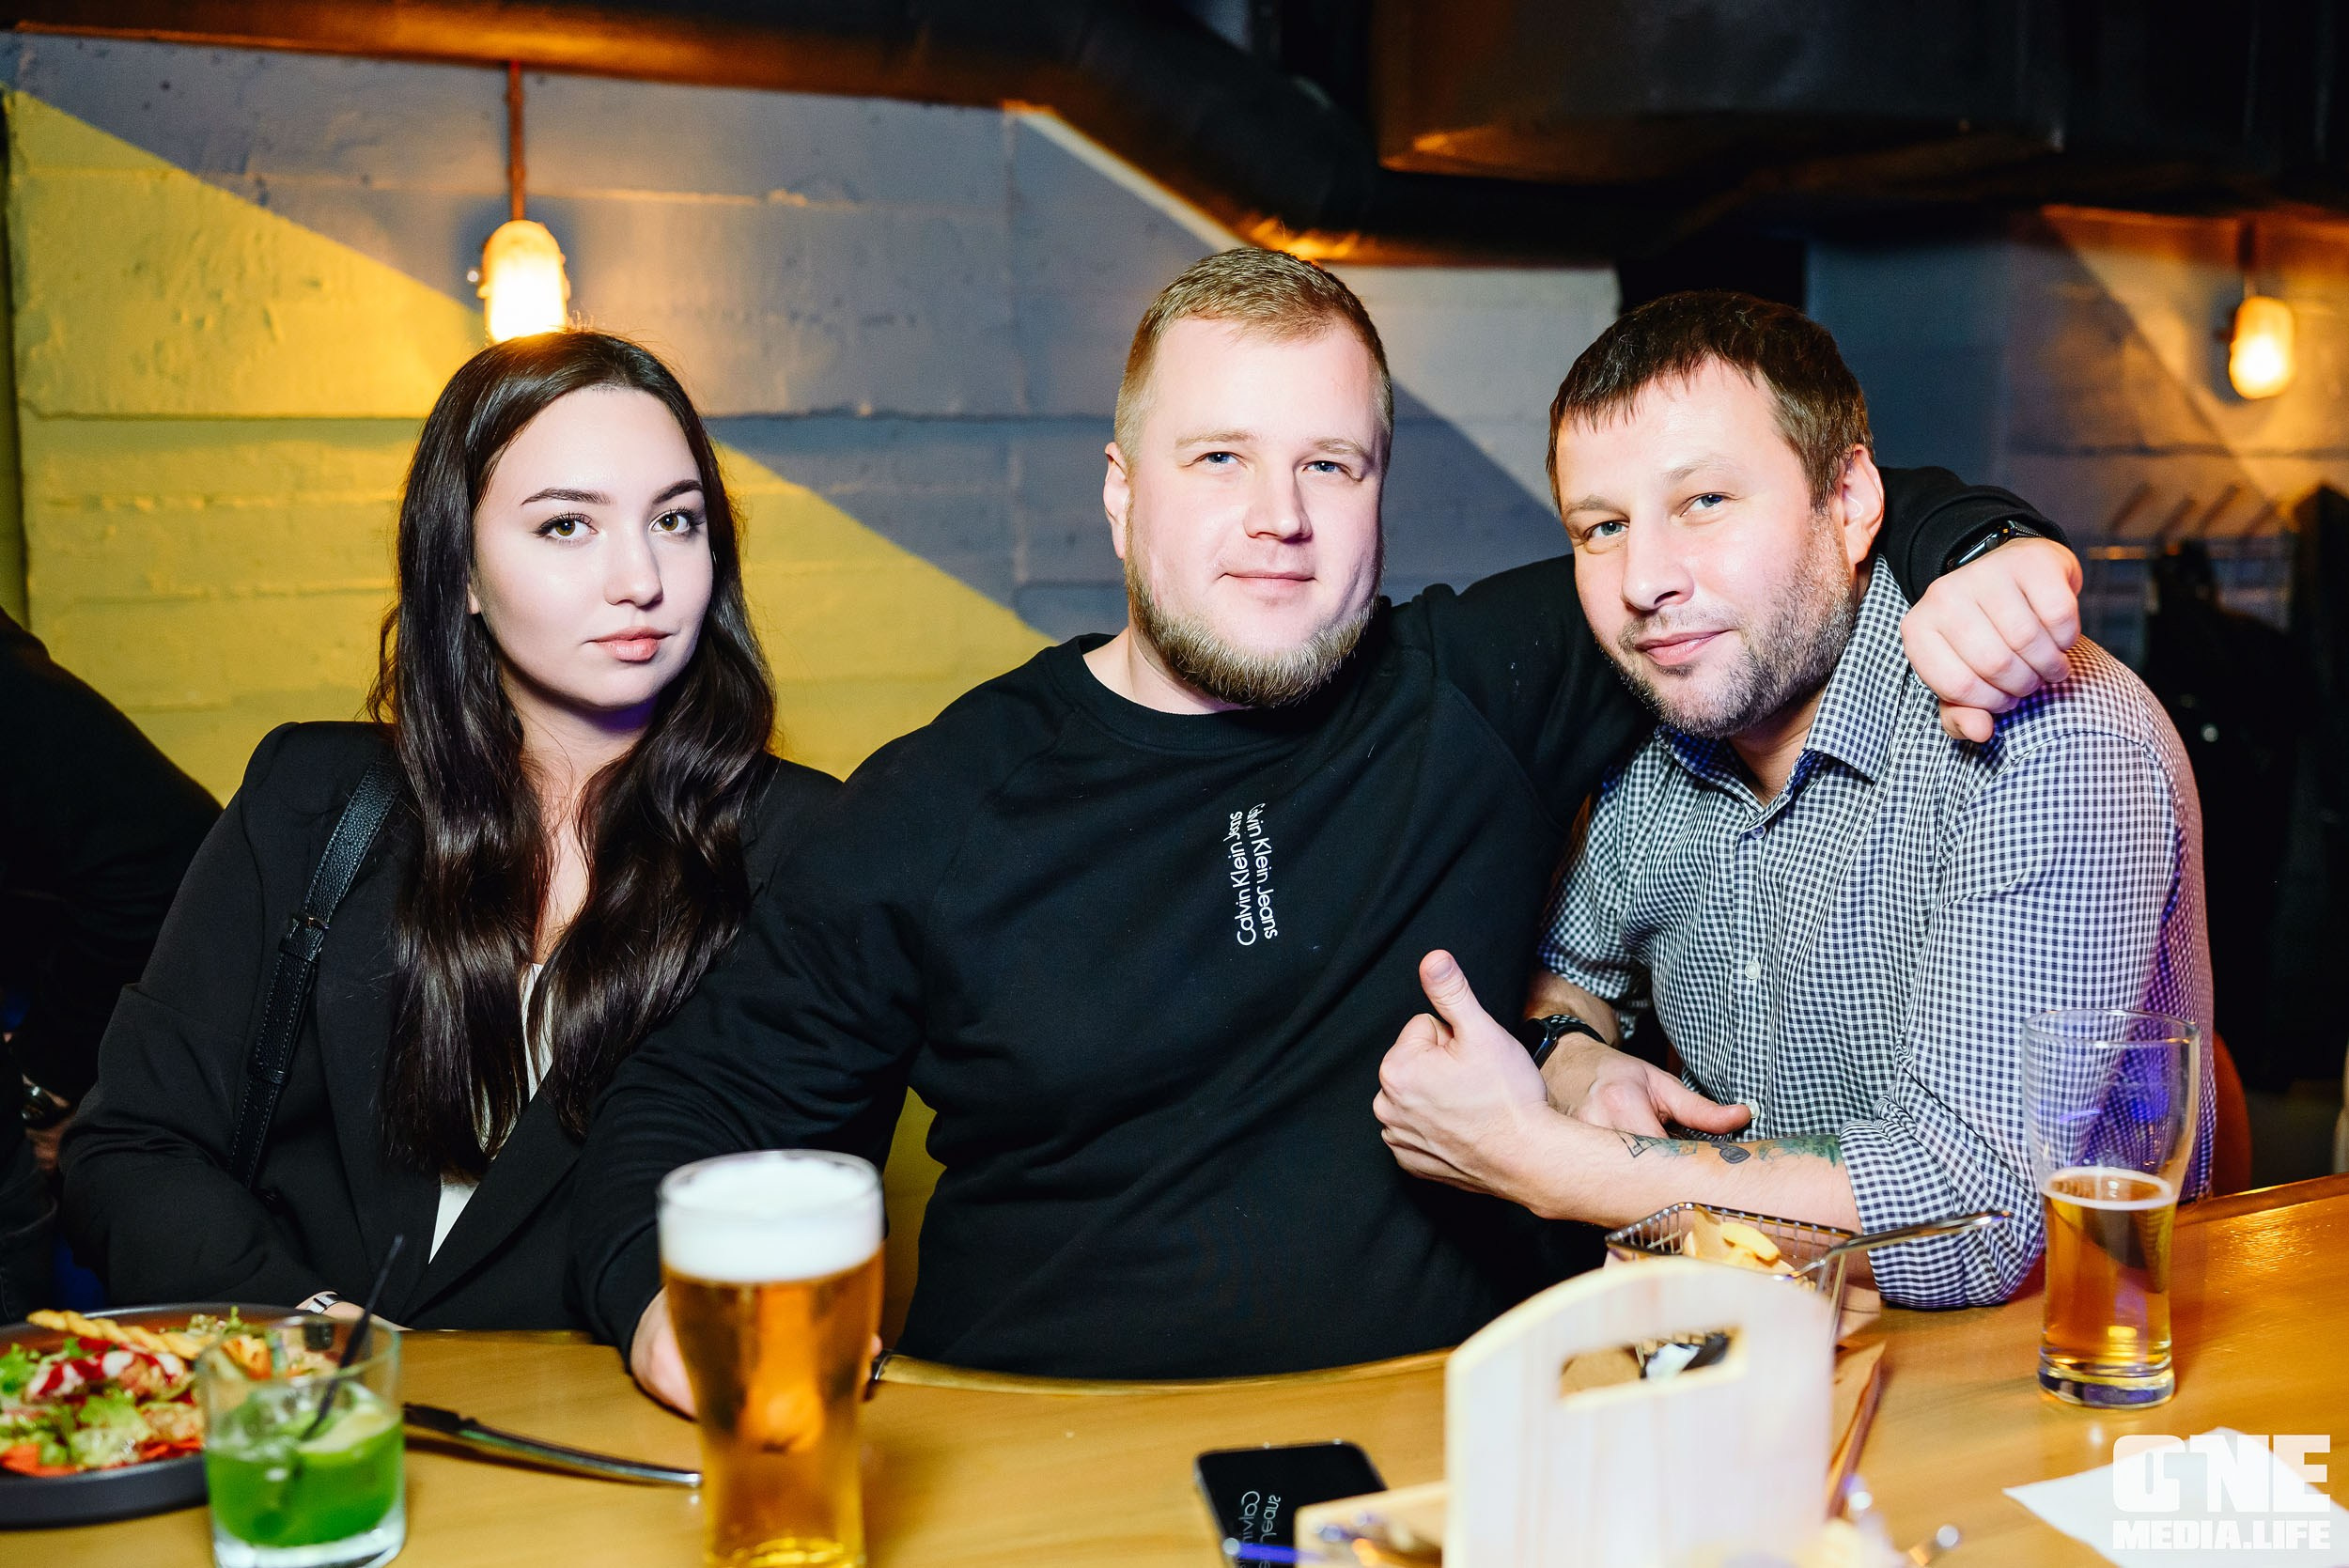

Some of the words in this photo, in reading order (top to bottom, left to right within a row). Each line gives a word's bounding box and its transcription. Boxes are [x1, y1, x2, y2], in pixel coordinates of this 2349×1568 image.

[1222, 811, 1243, 841] Jeans
[1228, 841, 1251, 888] Klein
[1251, 837, 1272, 884] Klein
[1235, 888, 1256, 946] Calvin
[1256, 886, 1278, 939] Jeans
